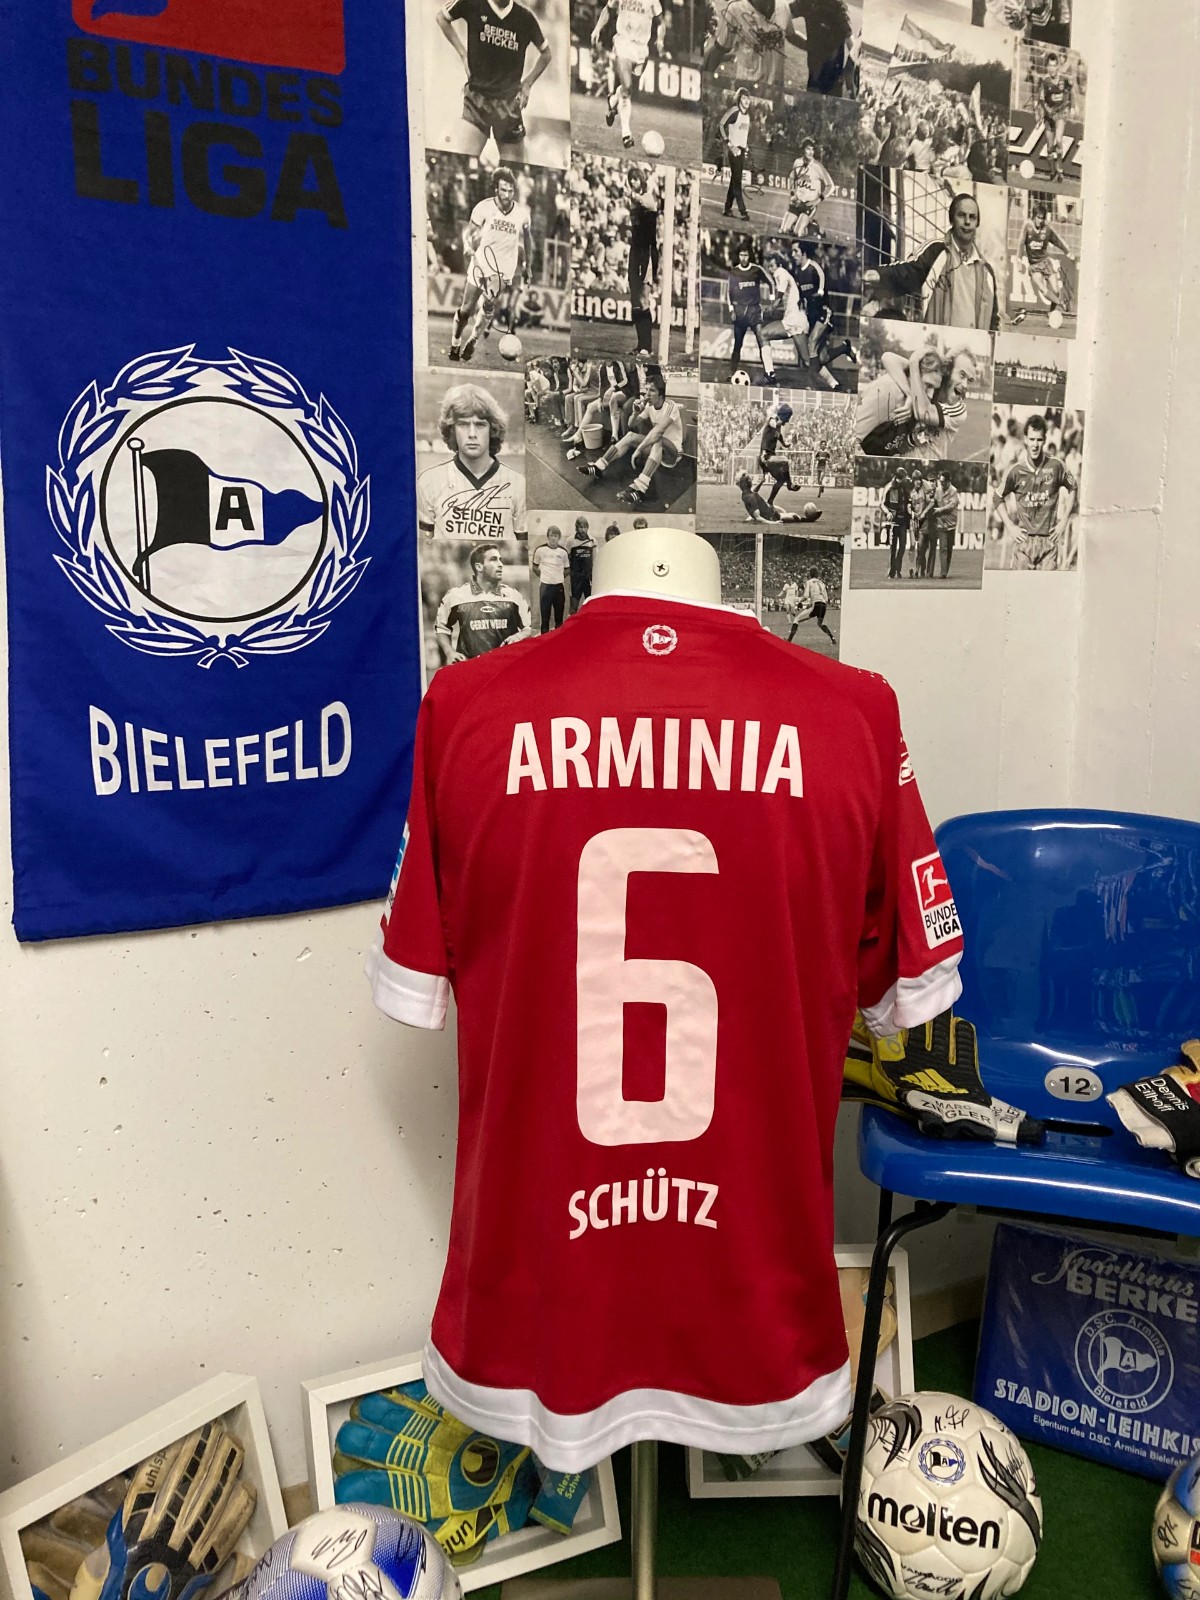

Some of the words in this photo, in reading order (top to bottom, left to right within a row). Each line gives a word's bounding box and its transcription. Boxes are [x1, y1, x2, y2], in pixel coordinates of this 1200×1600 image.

[480, 32, 519, 51] STICKER
[483, 24, 517, 41] SEIDEN
[67, 37, 344, 128] BUNDES
[70, 99, 349, 230] LIGA
[490, 224, 517, 235] STICKER
[493, 219, 516, 229] SEIDEN
[215, 486, 255, 531] A
[452, 506, 502, 525] SEIDEN
[445, 520, 505, 538] STICKER
[469, 619, 490, 631] GERRY
[490, 618, 508, 630] WEBER
[89, 701, 352, 796] BIELEFELD
[506, 716, 804, 798] ARMINIA
[924, 902, 958, 929] BUNDE
[933, 918, 961, 940] LIGA
[576, 827, 720, 1147] 6
[1059, 1076, 1091, 1096] 12
[1134, 1081, 1175, 1112] Eilhoff
[1150, 1077, 1190, 1111] Dennis
[567, 1166, 720, 1241] SCHÜTZ
[1128, 1316, 1166, 1357] Arminia
[1093, 1384, 1149, 1410] Bielefeld
[1070, 1427, 1086, 1439] des
[1114, 1440, 1148, 1458] Arminia
[867, 1492, 1001, 1550] molten
